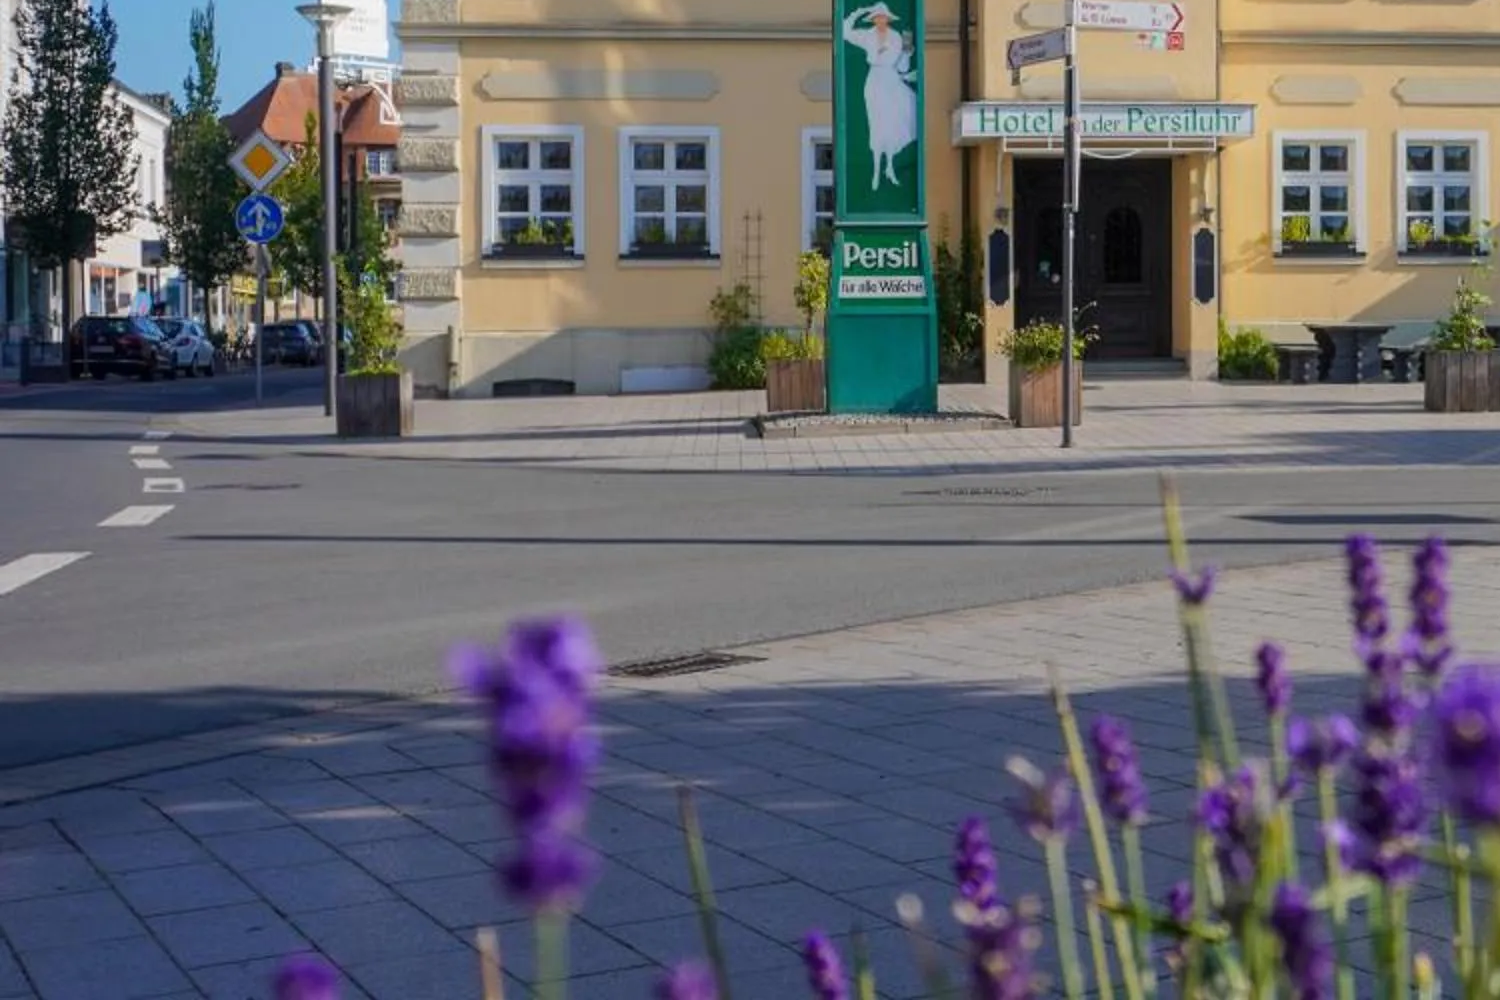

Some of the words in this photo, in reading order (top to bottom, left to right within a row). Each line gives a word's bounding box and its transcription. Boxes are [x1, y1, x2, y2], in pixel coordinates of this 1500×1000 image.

[979, 107, 1054, 133] Hotel
[1092, 114, 1121, 133] der
[1127, 106, 1242, 134] Persiluhr
[843, 240, 918, 269] Persil
[858, 279, 877, 293] alle
